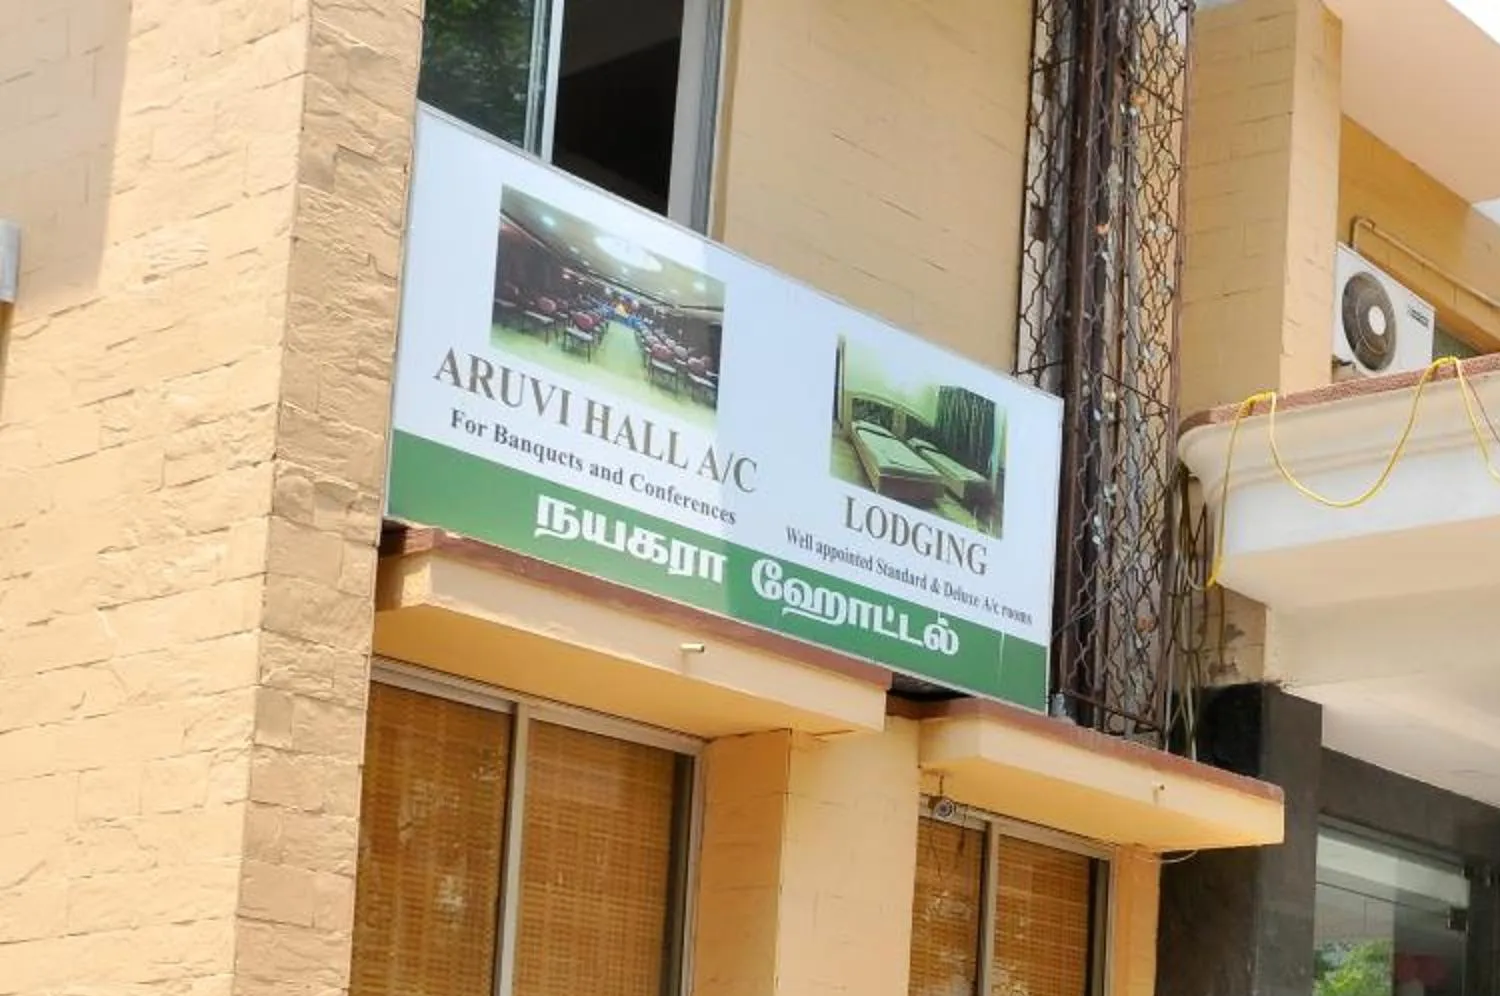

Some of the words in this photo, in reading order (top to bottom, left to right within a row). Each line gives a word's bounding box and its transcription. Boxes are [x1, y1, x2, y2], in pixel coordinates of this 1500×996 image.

[432, 346, 572, 427] ARUVI
[583, 397, 688, 470] HALL
[696, 445, 758, 493] A/C
[450, 406, 488, 438] For
[493, 422, 584, 473] Banquets
[589, 461, 624, 486] and
[629, 472, 737, 525] Conferences
[533, 493, 728, 585] நயகரா
[786, 525, 814, 551] Well
[815, 540, 873, 572] appointed
[875, 557, 928, 591] Standard
[929, 576, 941, 595] &
[943, 580, 981, 607] Deluxe
[845, 494, 988, 576] LODGING
